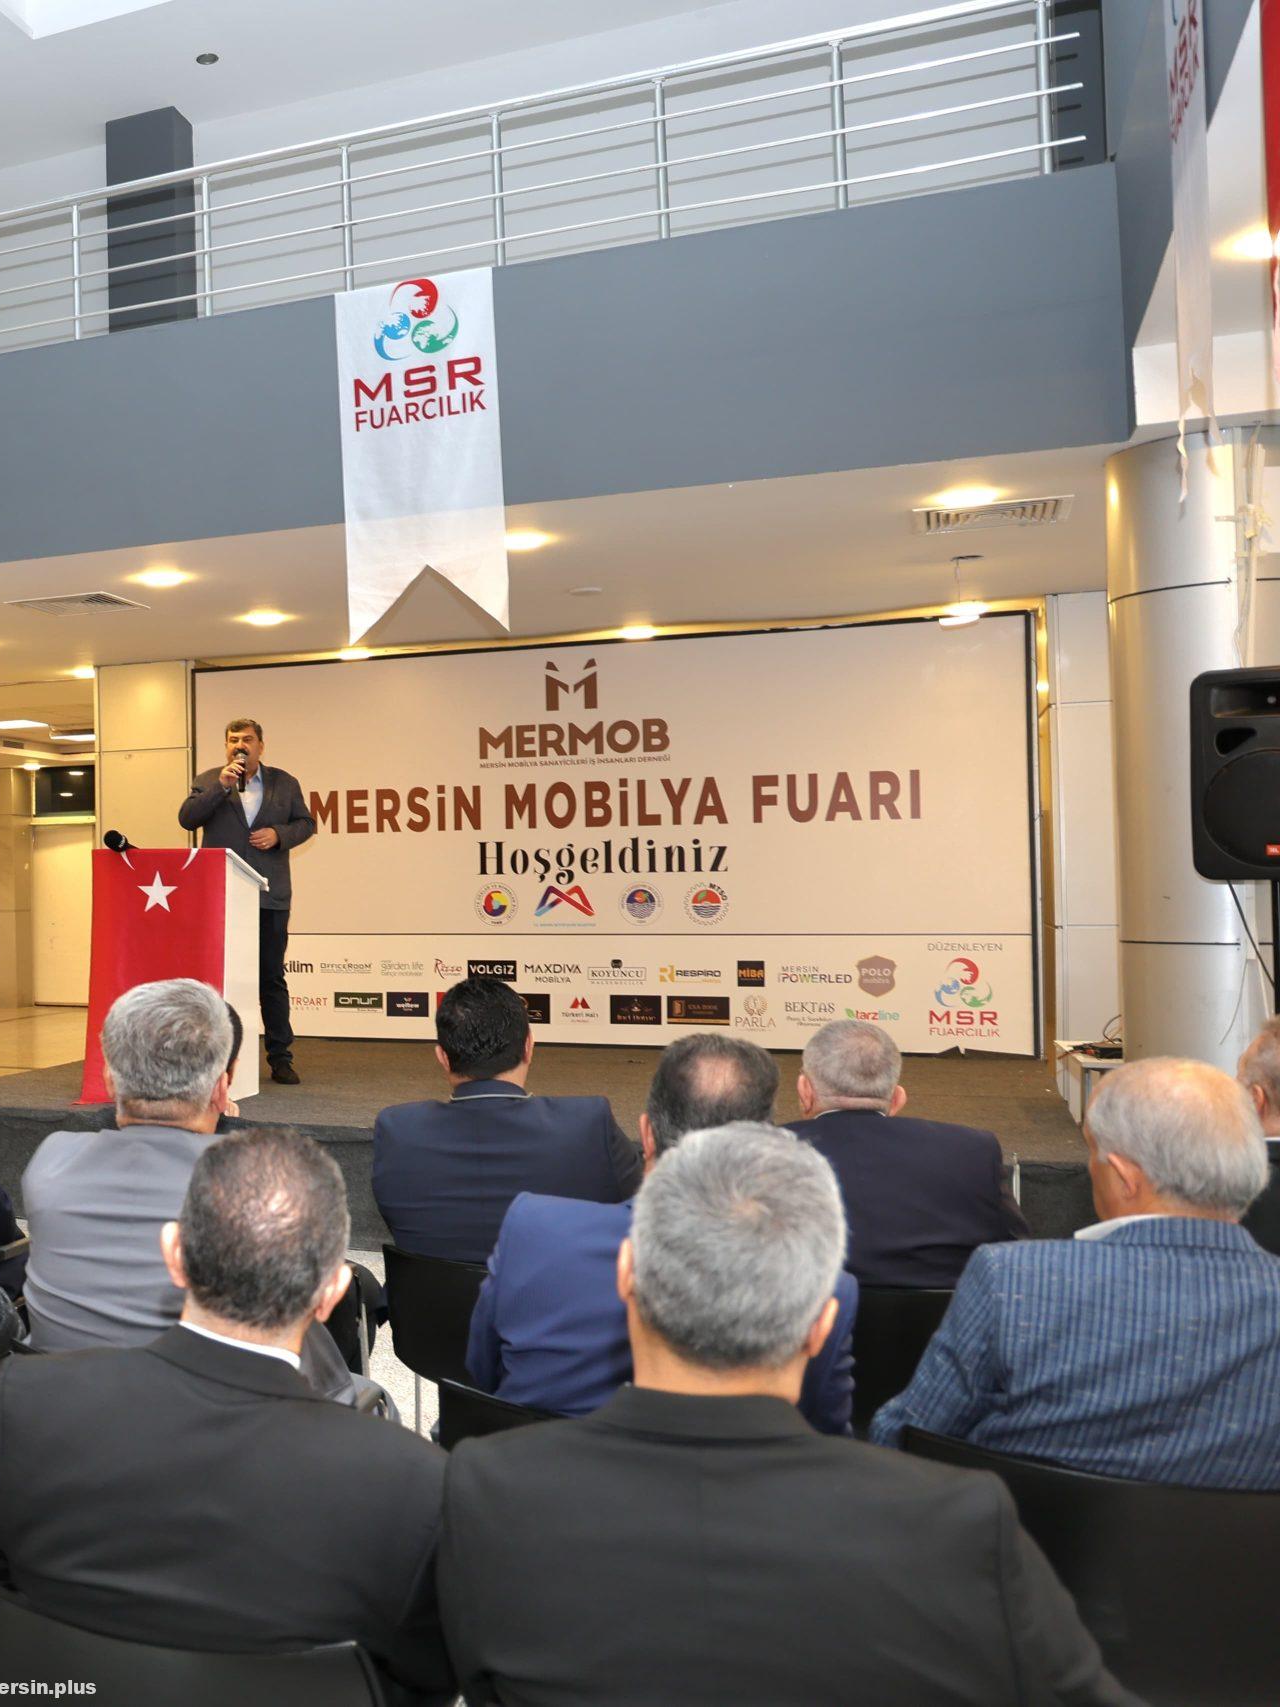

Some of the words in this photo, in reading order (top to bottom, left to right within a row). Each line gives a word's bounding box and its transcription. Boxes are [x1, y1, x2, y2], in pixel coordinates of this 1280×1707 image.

[353, 356, 486, 408] MSR
[355, 389, 487, 432] FUARCILIK
[479, 718, 670, 760] MERMOB
[752, 769, 921, 823] FUARI
[476, 836, 729, 886] Hoşgeldiniz
[927, 942, 1003, 952] DÜZENLEYEN
[590, 969, 644, 979] KOYUNCU
[861, 967, 892, 976] POLO
[781, 973, 853, 984] POWERLED
[855, 1009, 900, 1021] tarzline
[928, 1009, 999, 1026] MSR
[735, 1016, 777, 1028] PARLA
[928, 1027, 1001, 1038] FUARCILIK
